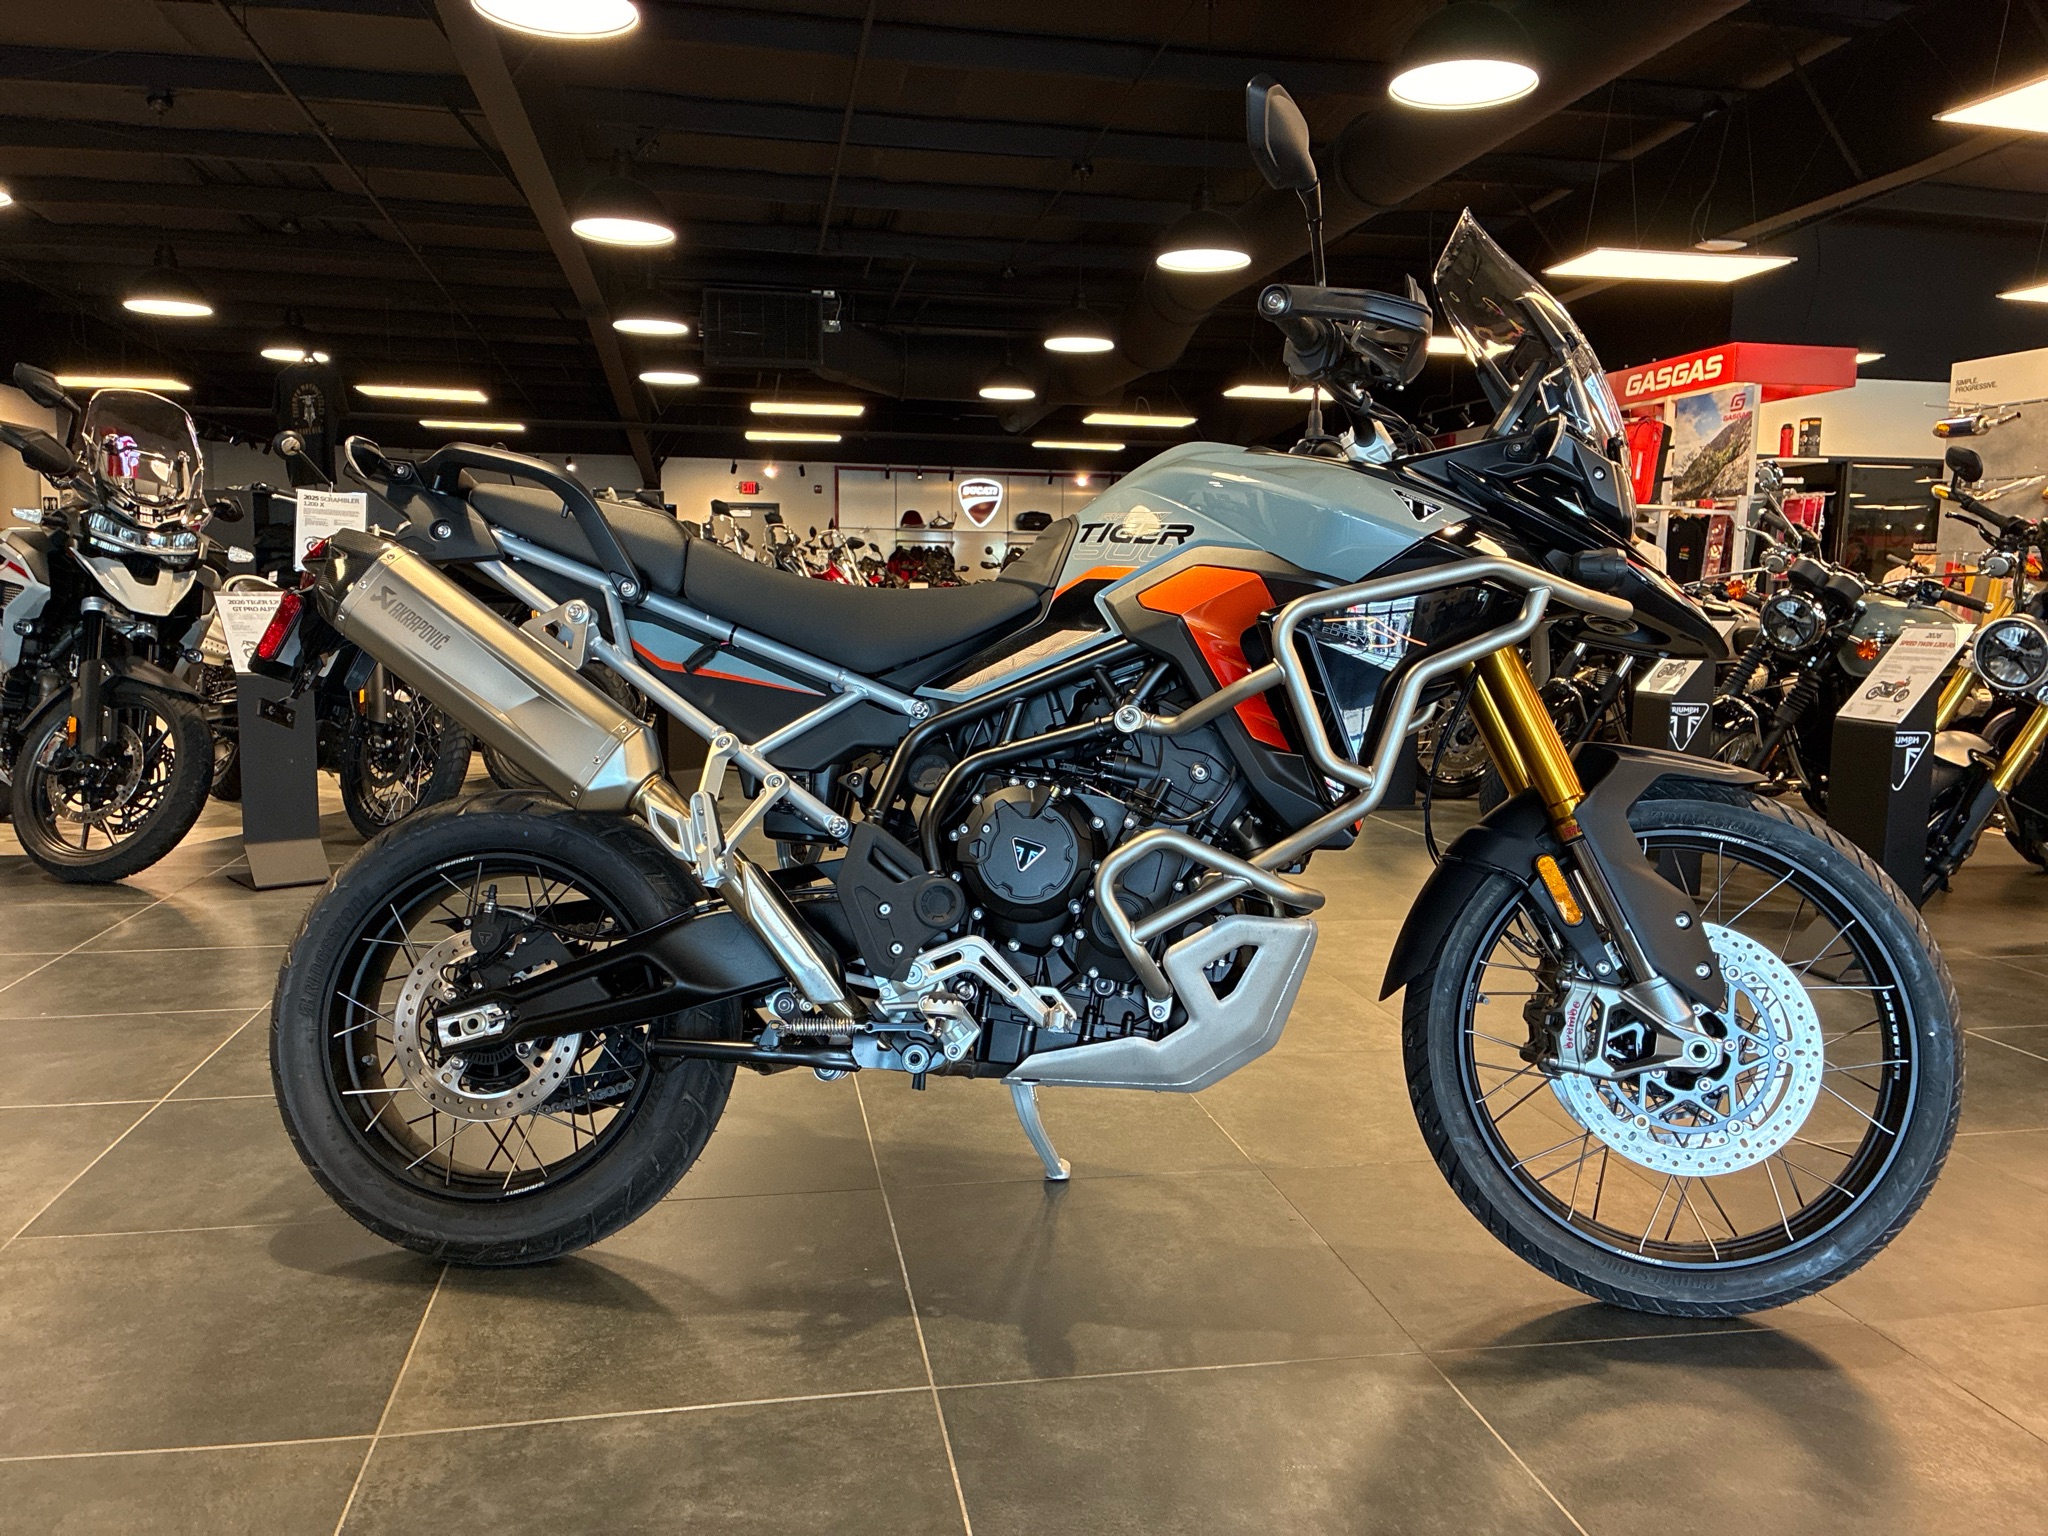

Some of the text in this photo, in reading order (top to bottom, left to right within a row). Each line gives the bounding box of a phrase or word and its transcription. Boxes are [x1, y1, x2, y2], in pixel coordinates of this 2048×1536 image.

[1625, 354, 1724, 397] GASGAS
[742, 482, 757, 494] EXIT
[962, 485, 998, 496] DUCATI
[303, 494, 360, 505] 2025 SCRAMBLER
[1079, 522, 1195, 545] TIGER
[388, 602, 451, 651] AKRAPOVIČ
[1322, 627, 1367, 644] EDITION
[1671, 706, 1699, 715] RIUMPH
[1563, 1001, 1581, 1049] brembo
